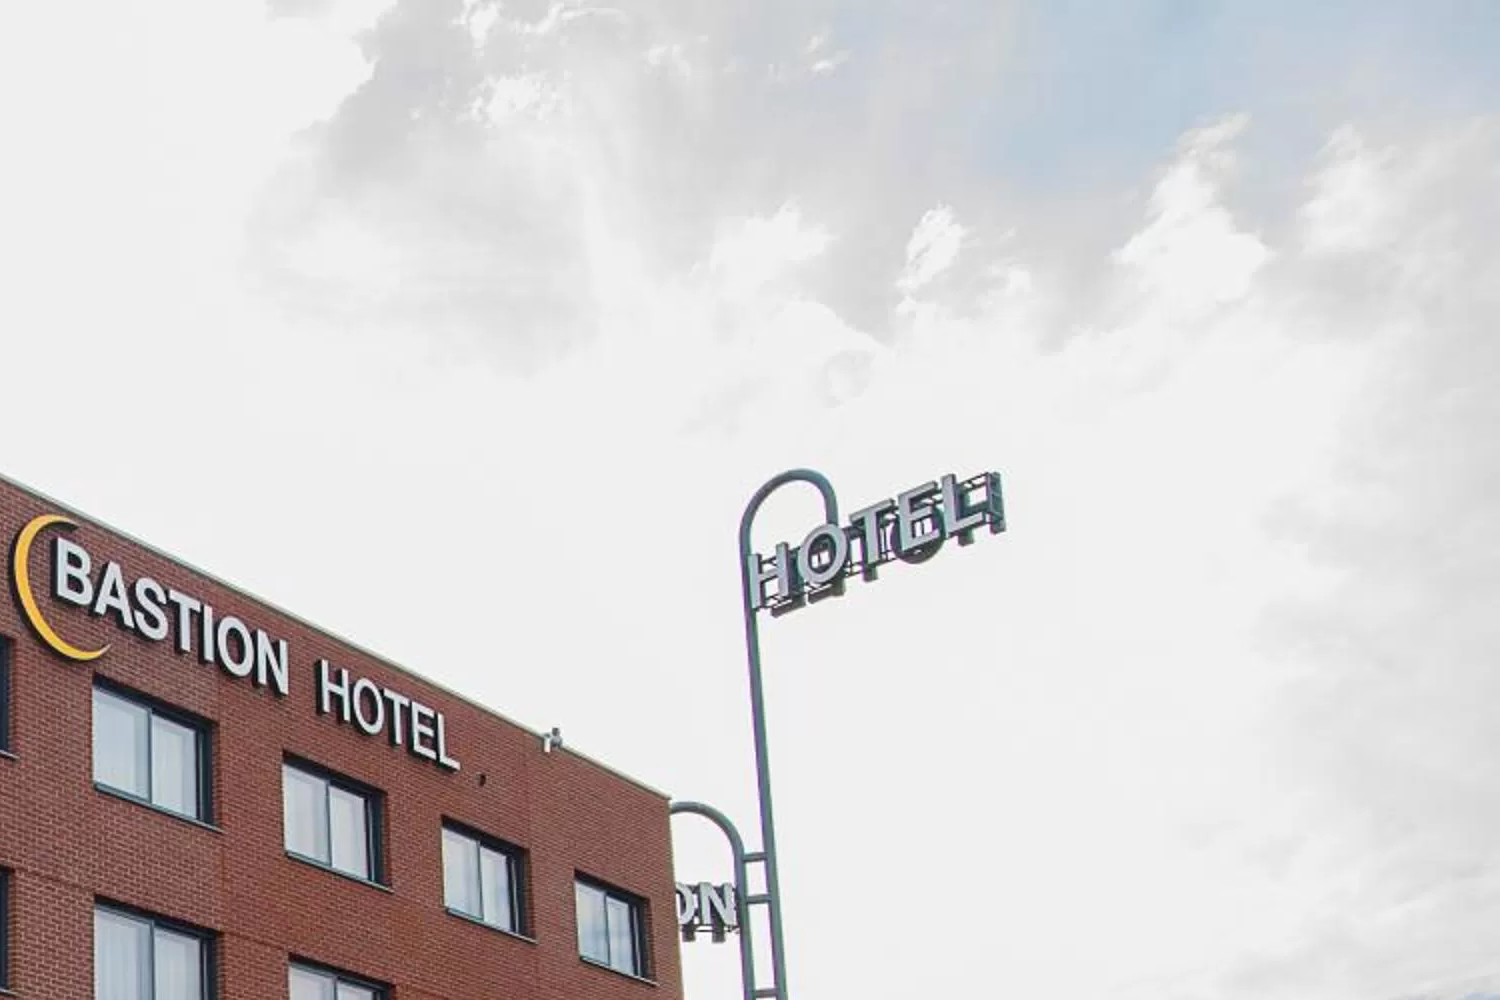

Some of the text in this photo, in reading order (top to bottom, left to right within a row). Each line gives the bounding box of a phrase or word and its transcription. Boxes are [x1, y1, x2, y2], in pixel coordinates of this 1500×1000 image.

[749, 474, 985, 610] HOTEL
[55, 536, 461, 772] BASTION HOTEL
